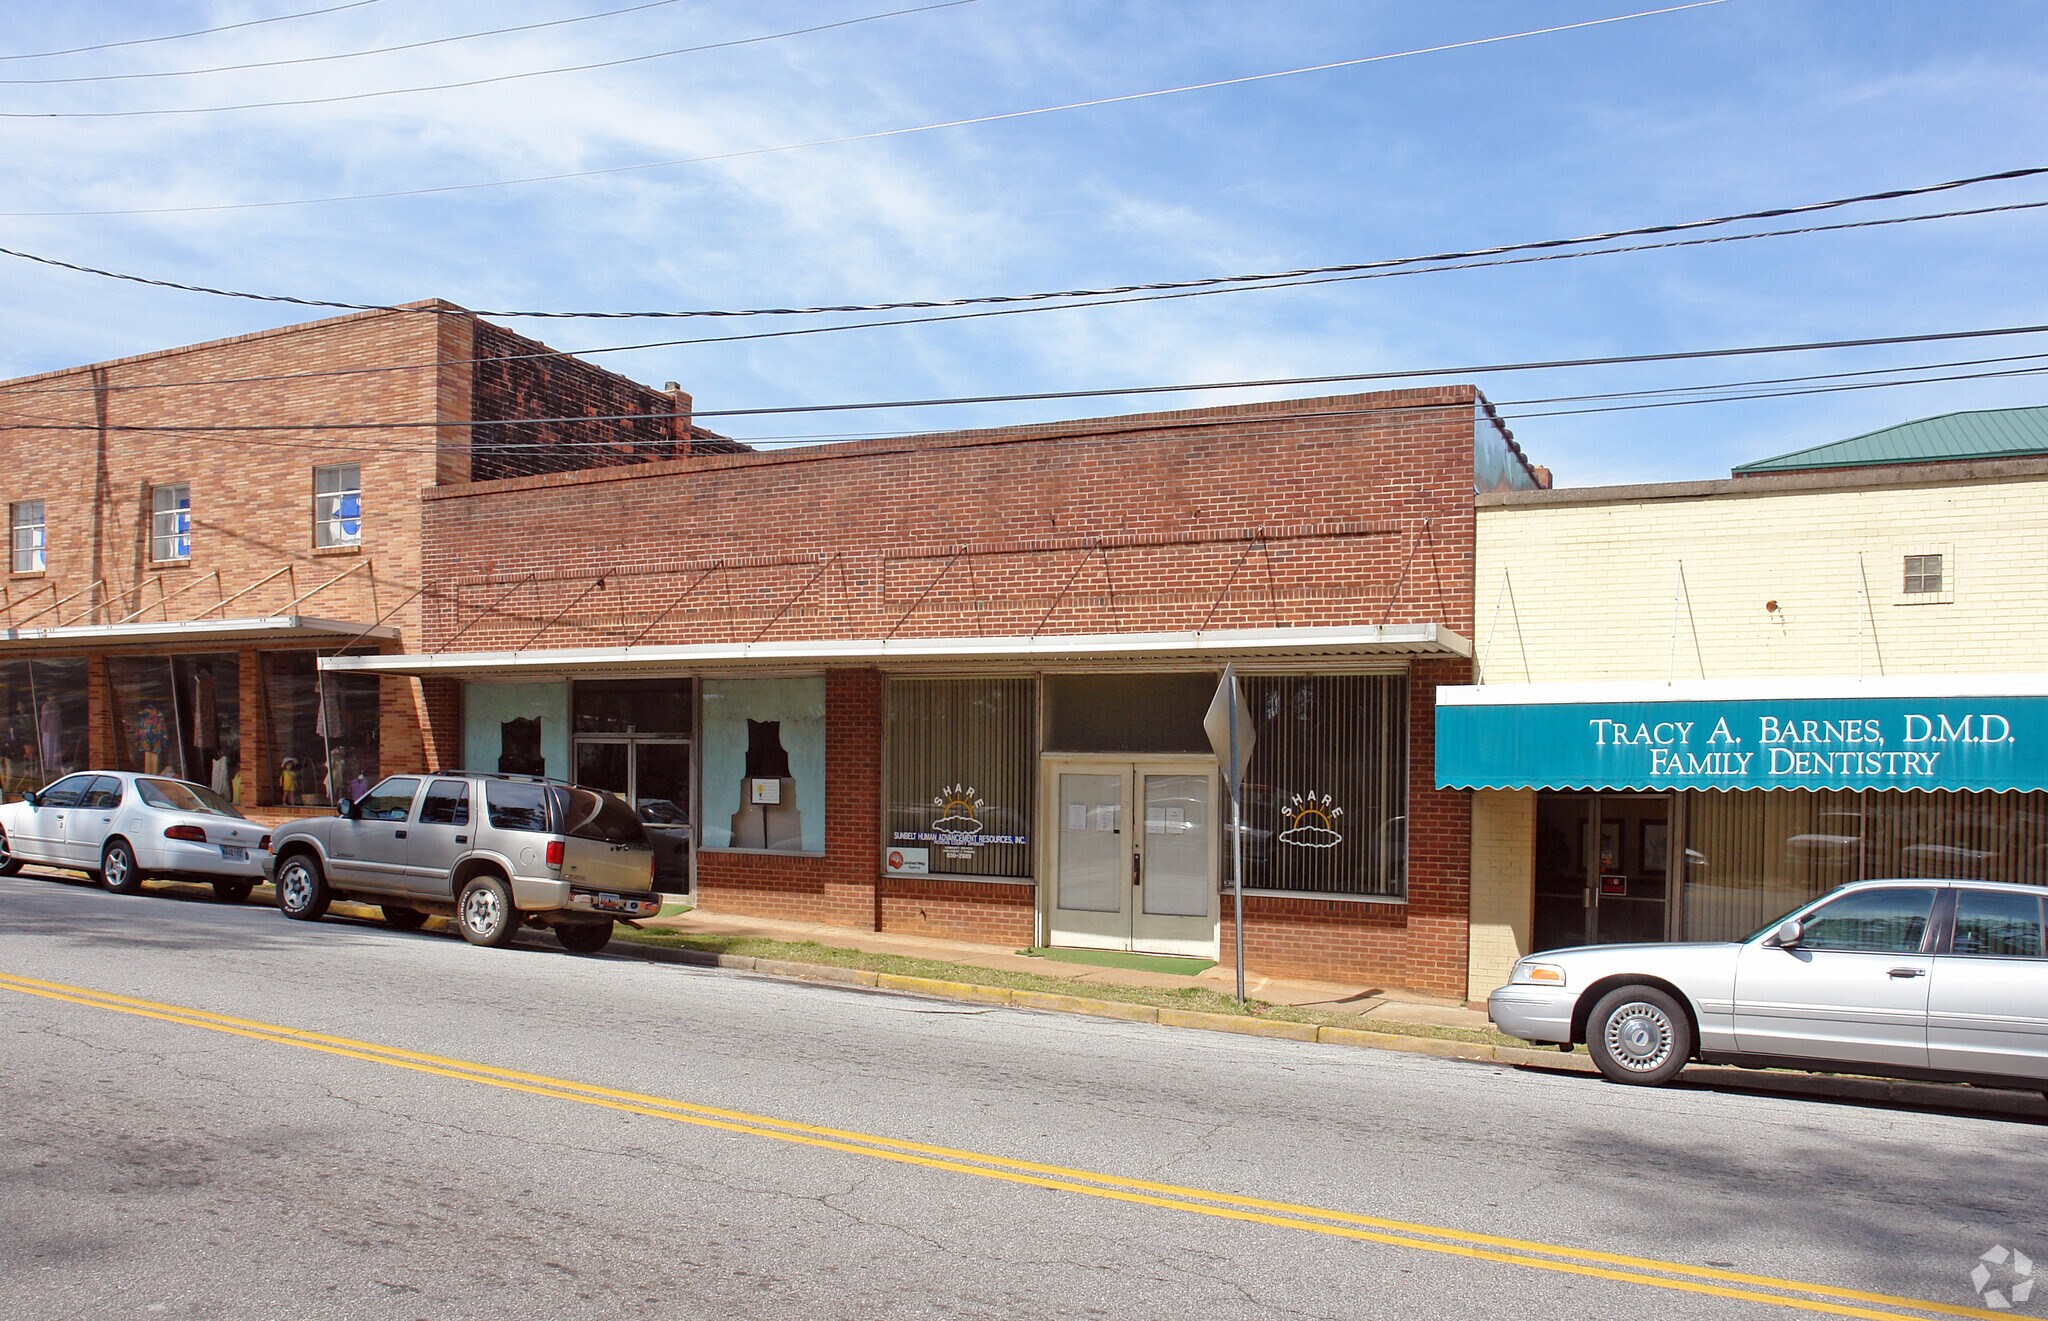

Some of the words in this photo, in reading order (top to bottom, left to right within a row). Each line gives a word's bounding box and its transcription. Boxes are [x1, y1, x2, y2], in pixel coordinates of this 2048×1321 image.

[1589, 718, 1694, 745] TRACY
[1706, 716, 1741, 744] A.
[1759, 716, 1884, 747] BARNES,
[1903, 714, 2015, 743] D.M.D.
[1650, 748, 1754, 775] FAMILY
[1768, 747, 1940, 775] DENTISTRY
[933, 783, 985, 809] SHARE
[1281, 790, 1343, 818] SHARE
[893, 832, 917, 840] SUNBELT
[917, 832, 937, 841] HUMAN
[938, 833, 977, 843] ADVANCEMENT
[1014, 836, 1027, 845] INC.
